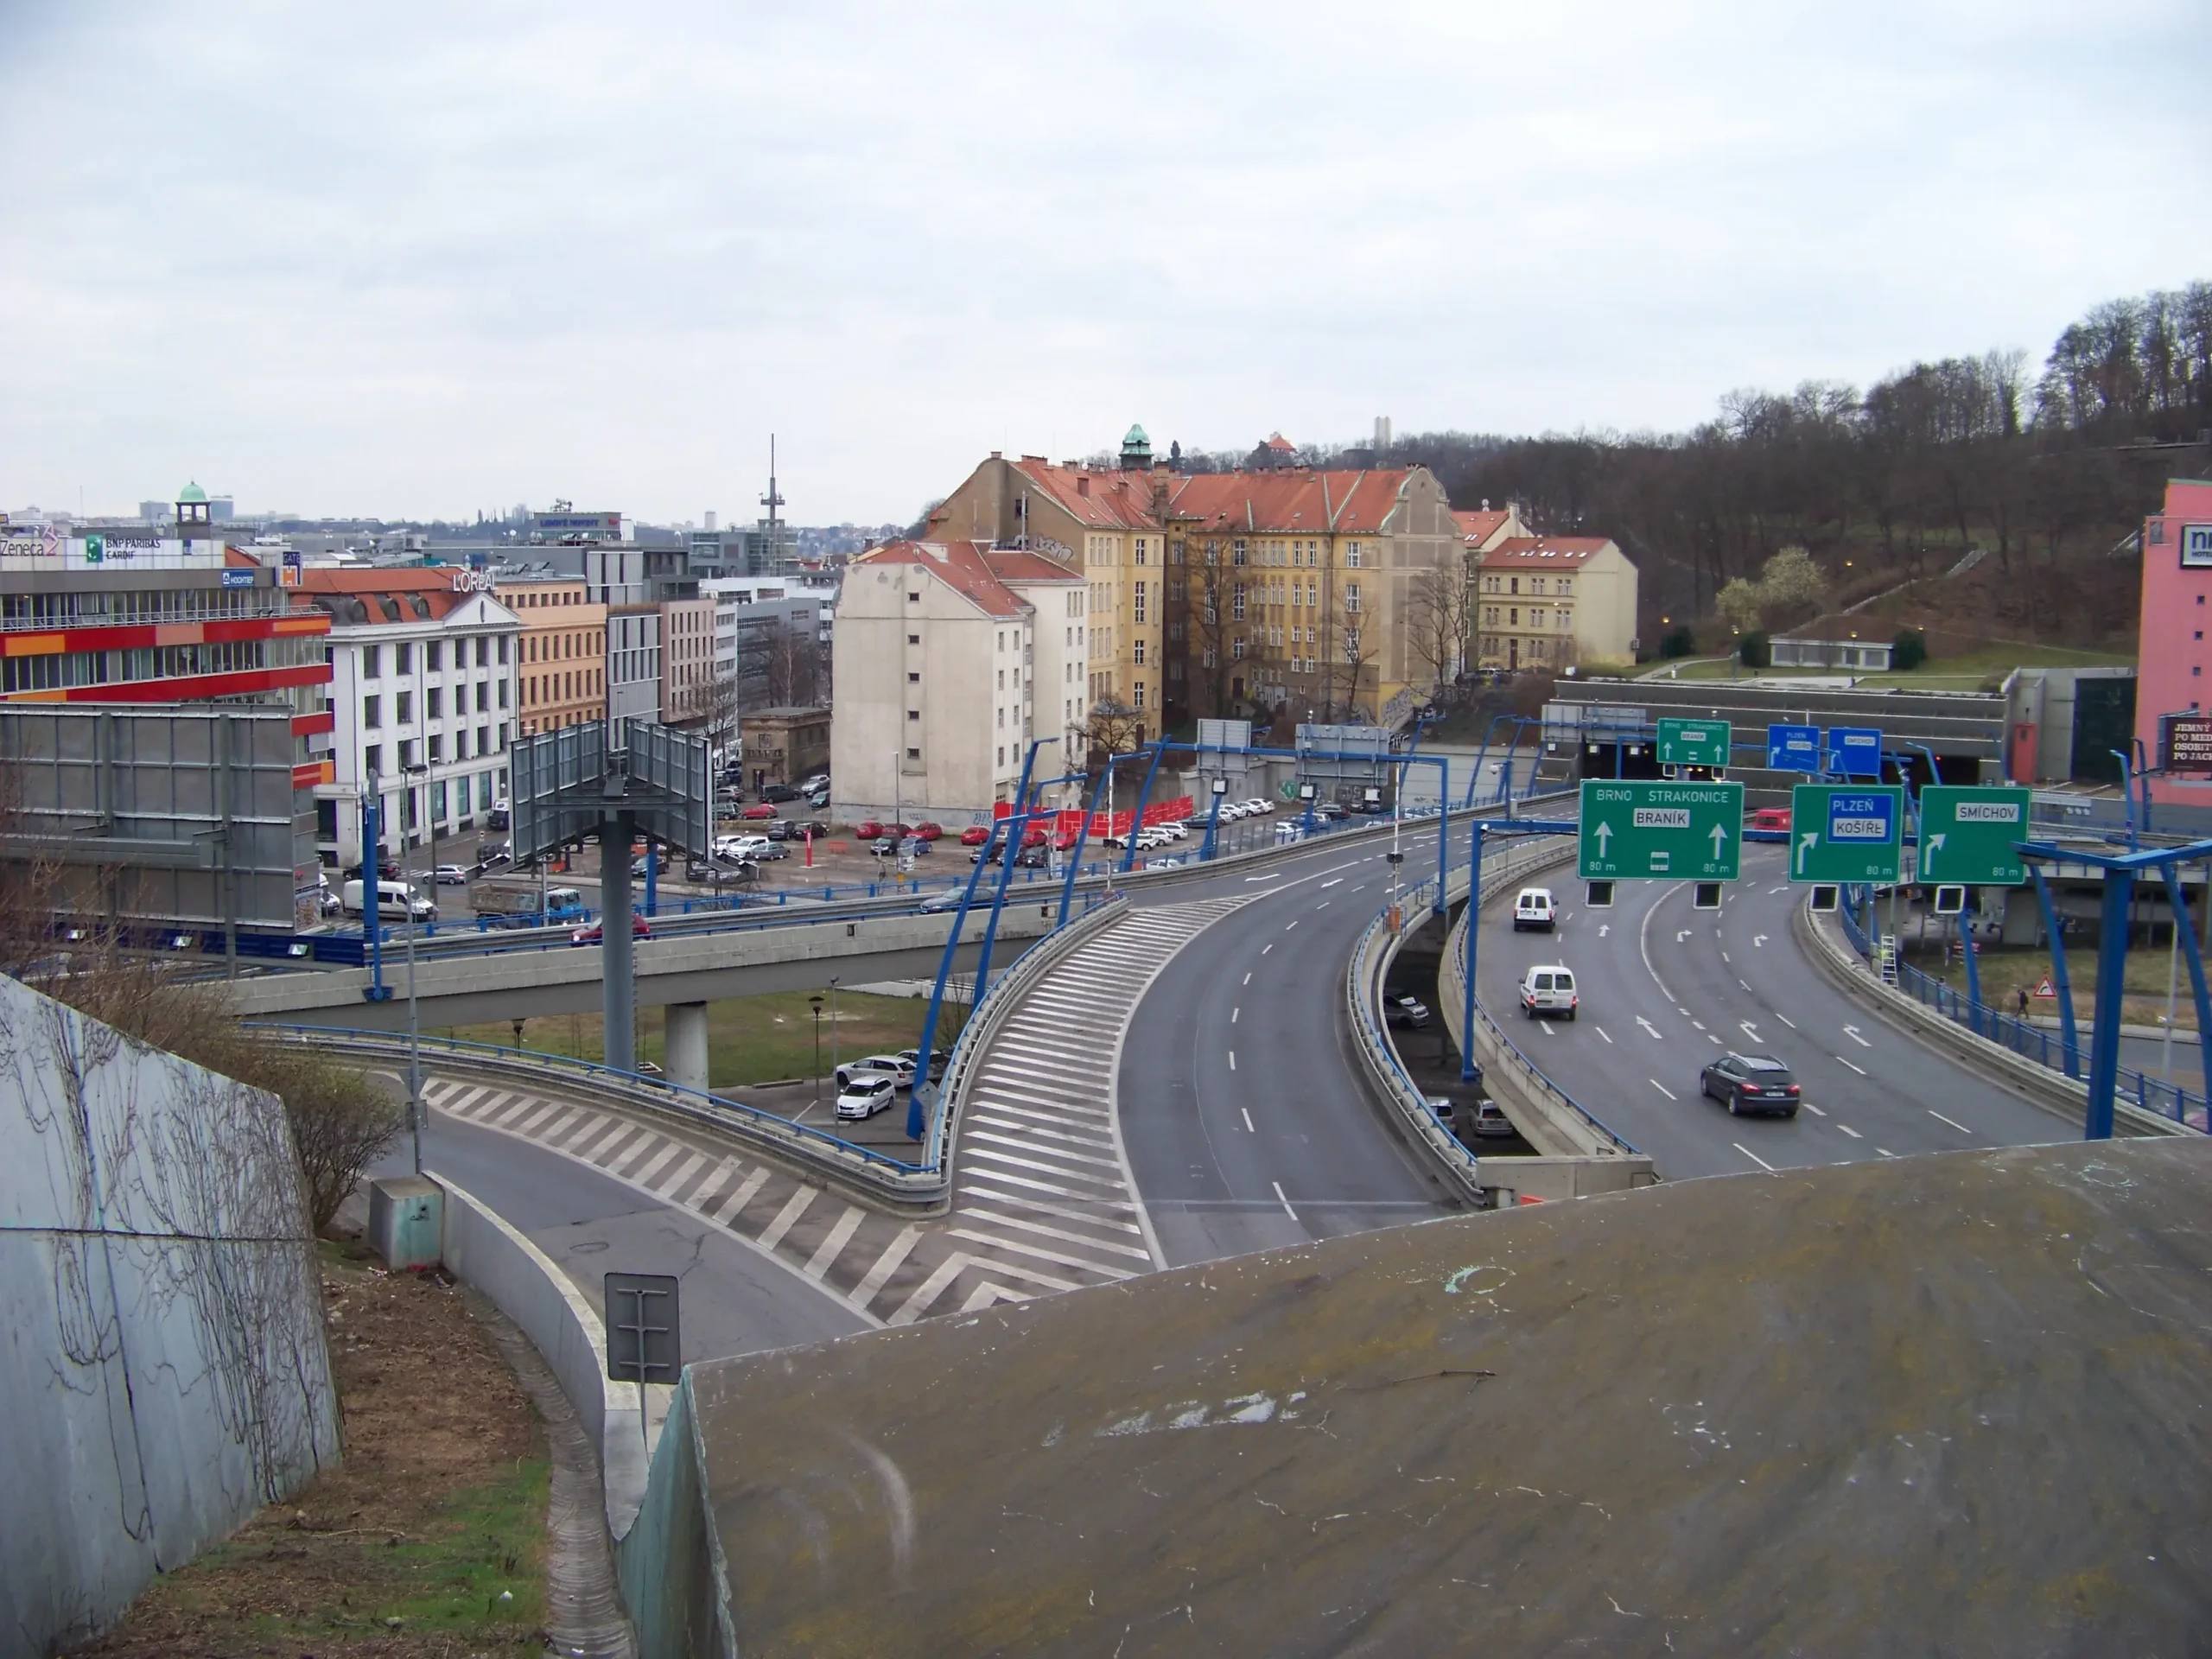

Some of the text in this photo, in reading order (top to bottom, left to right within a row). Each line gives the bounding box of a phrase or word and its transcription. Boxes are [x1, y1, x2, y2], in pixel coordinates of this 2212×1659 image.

[0, 540, 43, 556] Zeneca
[106, 538, 161, 549] BNP PARIBAS
[106, 550, 136, 560] CARDIF
[283, 553, 301, 563] GATE
[2174, 722, 2211, 732] JEMNÝ
[2174, 733, 2189, 741] PO
[2174, 742, 2212, 751] OSOBIT
[2173, 752, 2188, 760] PO
[1596, 789, 1729, 804] BRNO STRAKONICE
[1833, 798, 1874, 812] PLZEŇ
[1959, 804, 2016, 819] SMÍCHOV
[1636, 810, 1687, 824] BRANÍK
[1836, 819, 1882, 835] KOŠÍŘE
[1589, 861, 1616, 872] 80 m
[1703, 863, 1716, 873] 80
[1866, 866, 1892, 876] 80 m
[1993, 867, 2018, 877] 80 m
